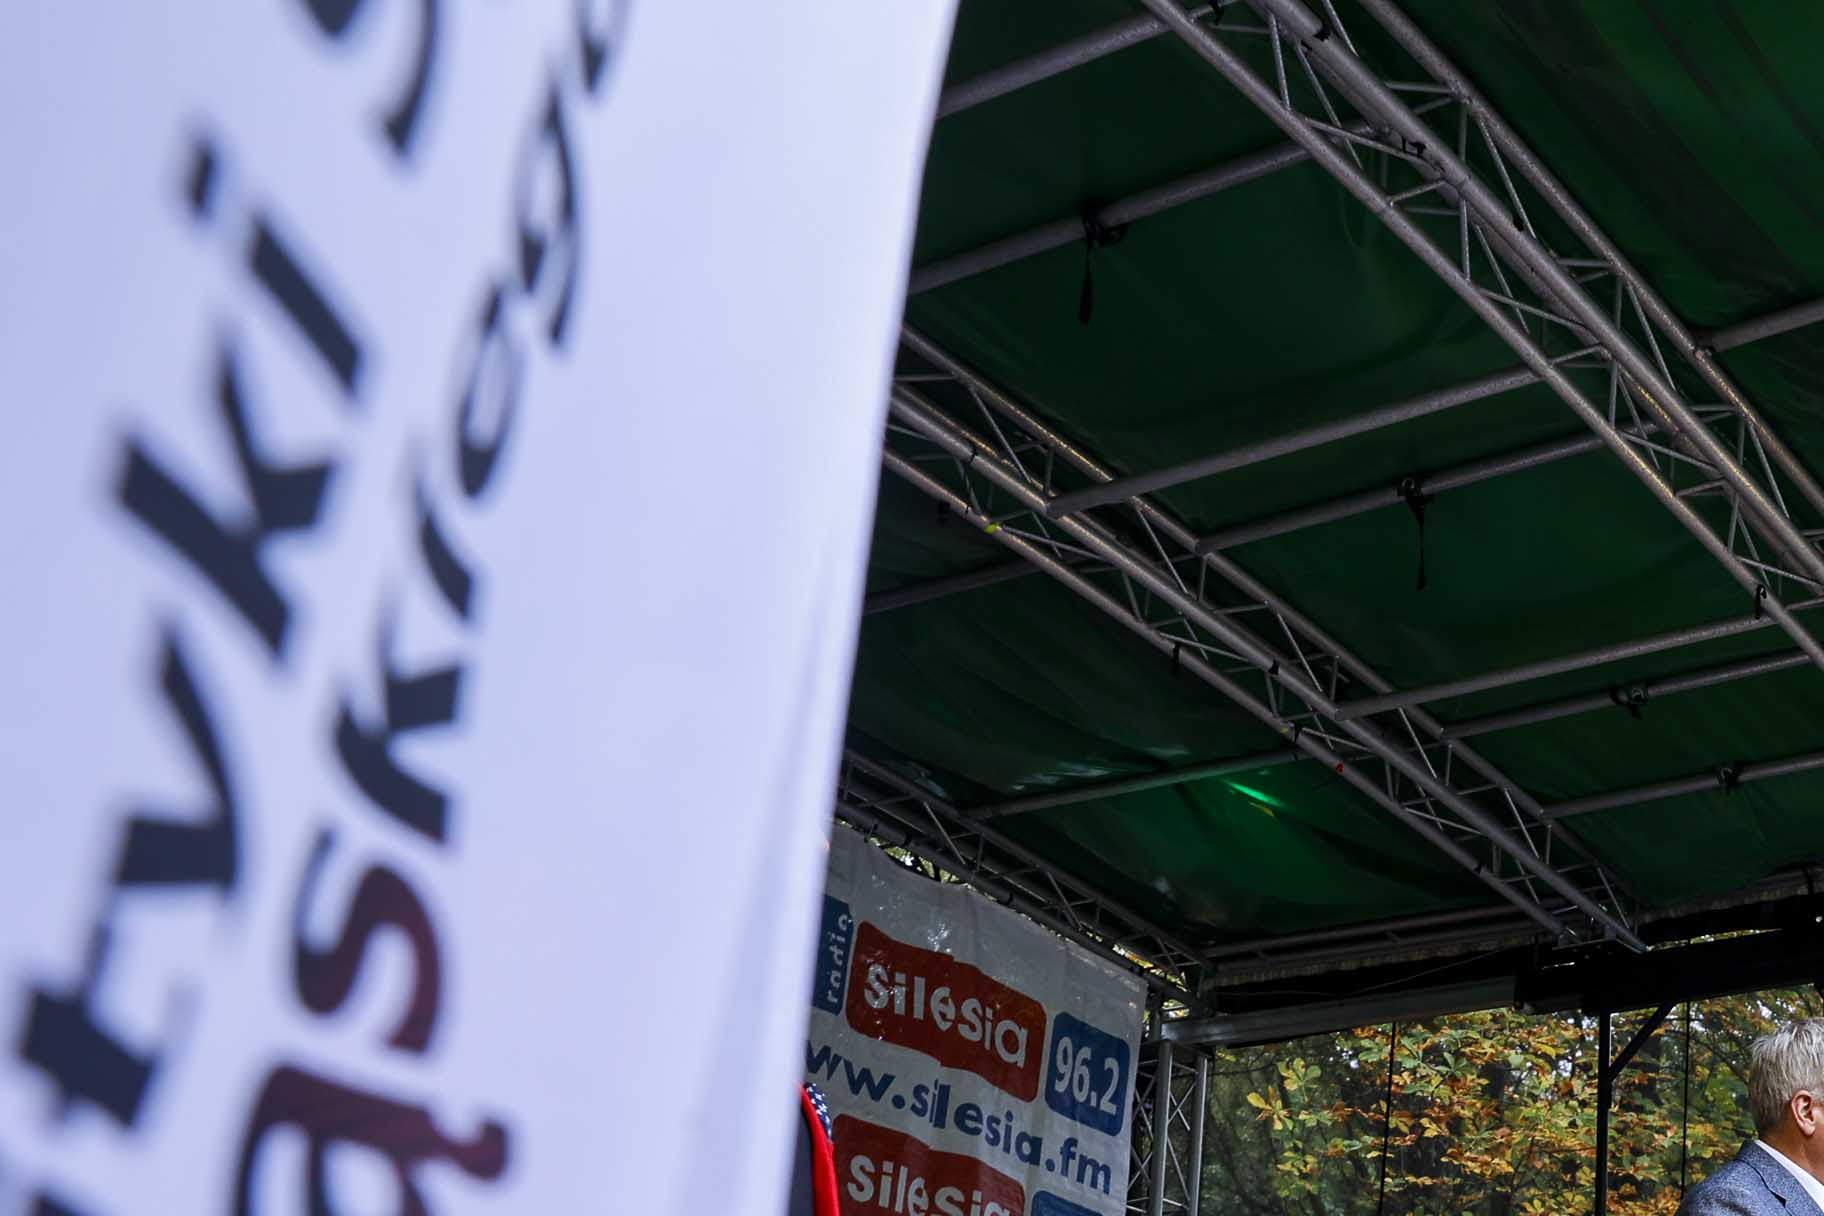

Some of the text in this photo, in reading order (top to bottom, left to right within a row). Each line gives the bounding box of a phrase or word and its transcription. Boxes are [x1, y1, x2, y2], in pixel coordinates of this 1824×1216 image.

[825, 914, 850, 1004] radio
[805, 1041, 1112, 1196] ww.silesia.fm
[1053, 1036, 1121, 1116] 96.2
